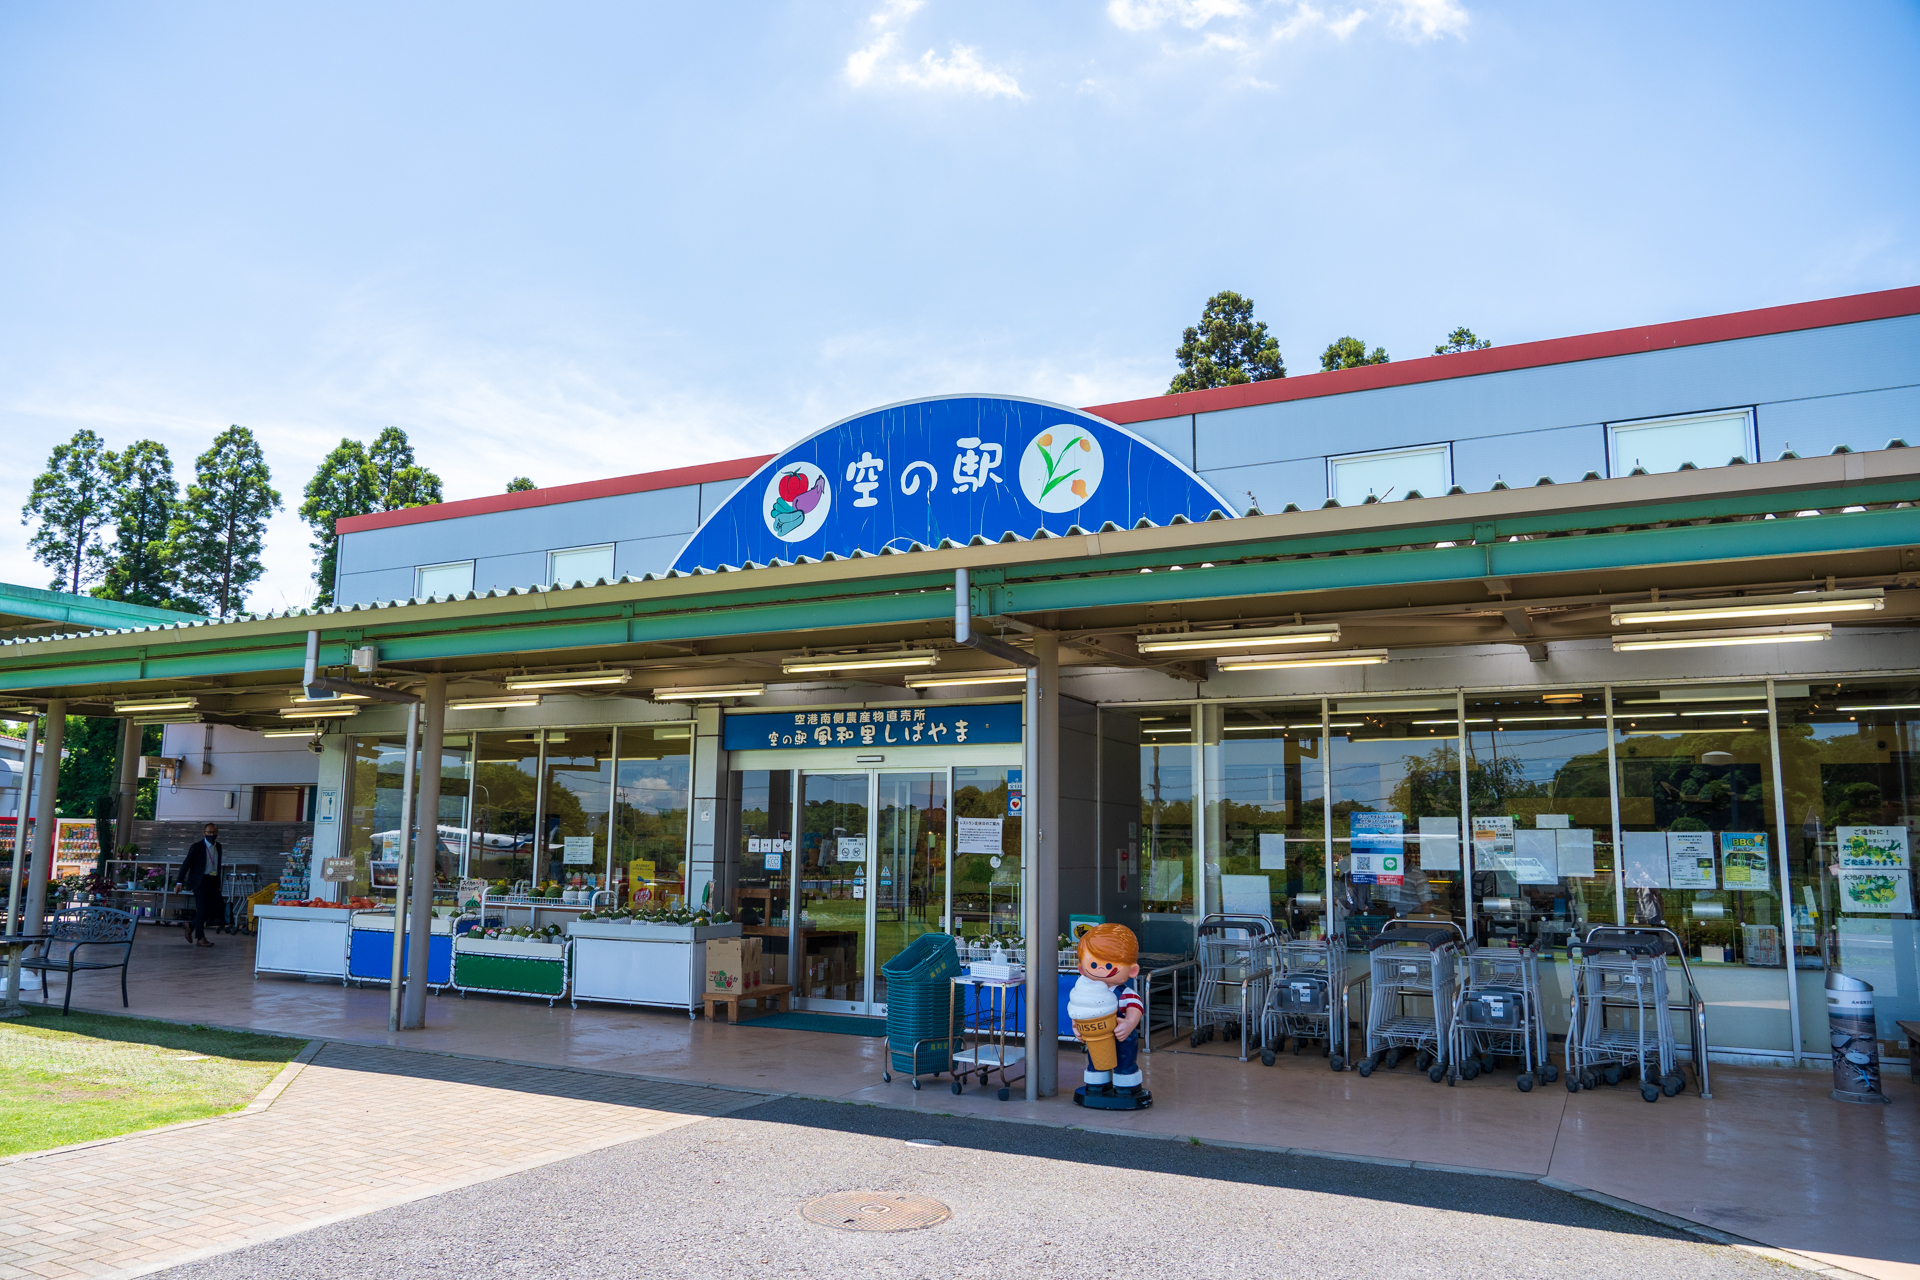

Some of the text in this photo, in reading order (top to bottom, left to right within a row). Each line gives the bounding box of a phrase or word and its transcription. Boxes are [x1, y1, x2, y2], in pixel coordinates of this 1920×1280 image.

[846, 437, 1004, 508] 空の駅
[794, 709, 926, 726] 空港南側農産物直売所
[768, 719, 970, 747] 空の駅 風和里しばやま
[1732, 837, 1756, 848] BBQ
[1076, 1021, 1108, 1033] NISSEI
